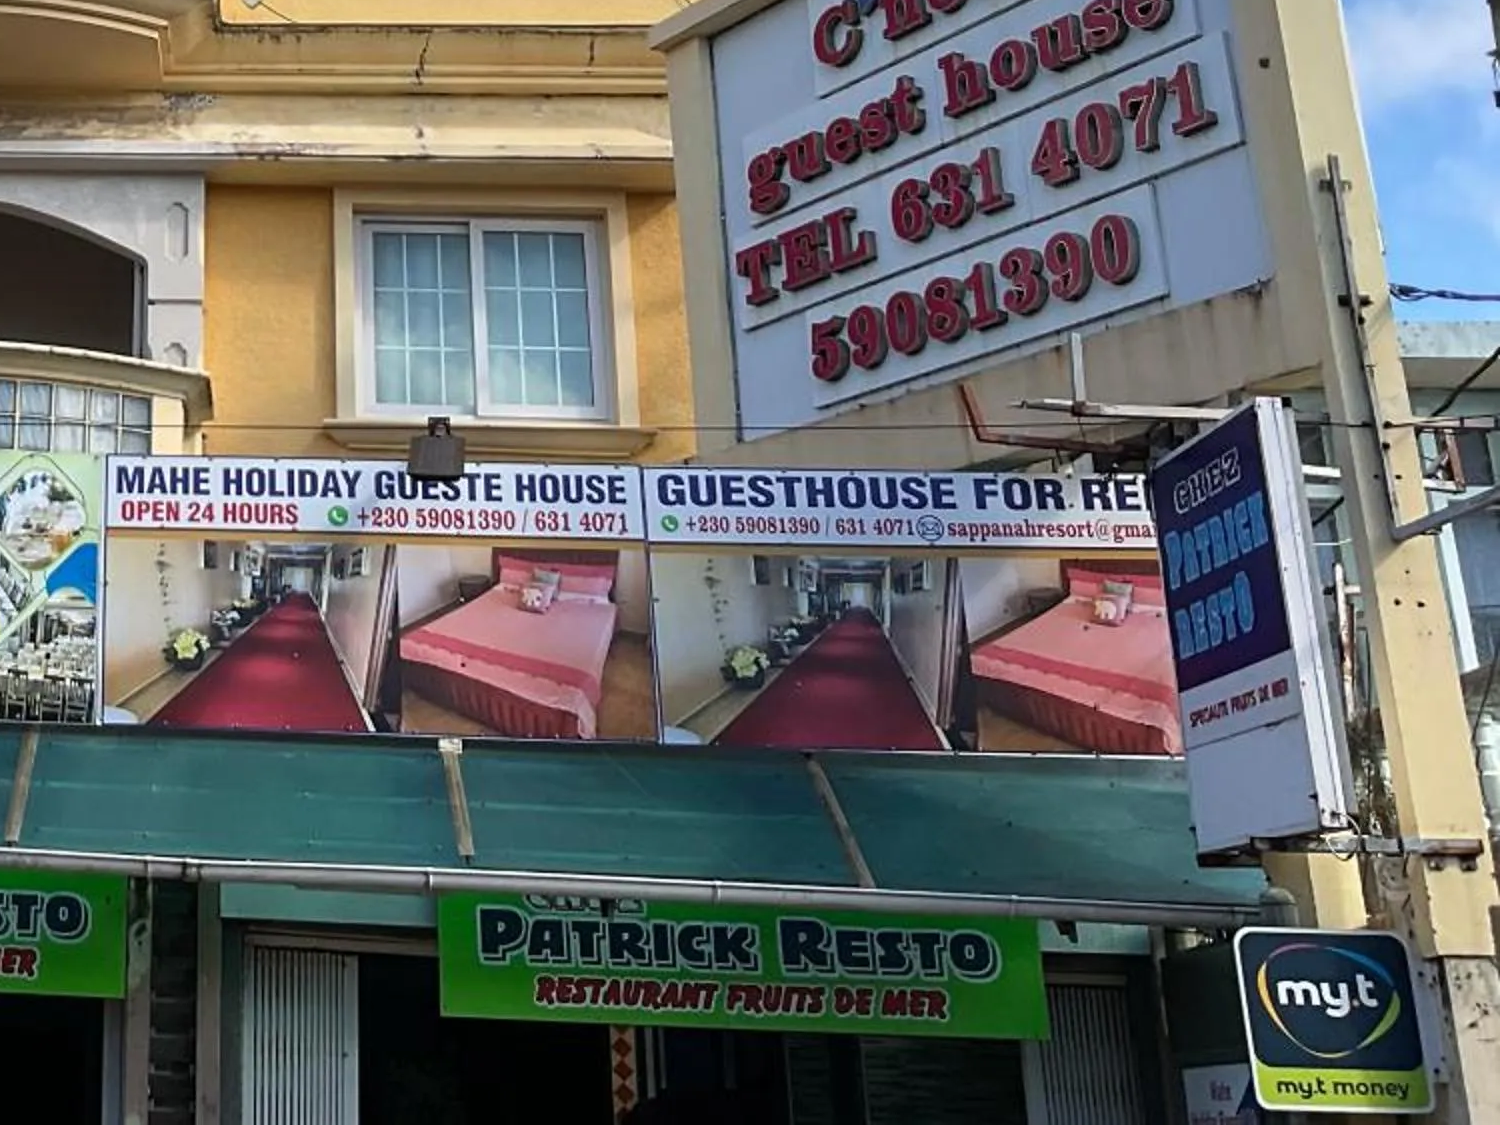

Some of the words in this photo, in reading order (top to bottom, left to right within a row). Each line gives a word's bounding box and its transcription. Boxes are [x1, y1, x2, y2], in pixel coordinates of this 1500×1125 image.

[746, 73, 927, 215] guest
[736, 206, 877, 306] TEL
[891, 147, 1015, 242] 631
[1031, 61, 1218, 185] 4071
[811, 214, 1140, 382] 59081390
[116, 466, 211, 496] MAHE
[223, 468, 362, 498] HOLIDAY
[375, 472, 500, 502] GUESTE
[515, 474, 627, 504] HOUSE
[657, 474, 957, 509] GUESTHOUSE
[973, 478, 1065, 510] FOR
[1081, 478, 1155, 510] RE
[1172, 447, 1241, 515] CHEZ
[121, 501, 179, 522] OPEN
[187, 502, 215, 522] 24
[223, 503, 298, 524] HOURS
[356, 508, 408, 528] +230
[415, 508, 515, 531] 59081390
[535, 511, 571, 532] 631
[579, 512, 628, 533] 4071
[686, 516, 729, 534] +230
[735, 516, 820, 535] 59081390
[835, 518, 866, 536] 631
[873, 518, 914, 537] 4071
[1173, 570, 1256, 660] RESTO
[475, 905, 761, 973] PATRICK
[776, 916, 1002, 981] RESTO
[534, 976, 720, 1013] RESTAURANT
[725, 982, 826, 1019] FRUITS
[834, 986, 875, 1019] DE
[881, 988, 948, 1021] MER
[1277, 974, 1378, 1018] my.t
[1277, 1077, 1326, 1099] my.t
[1333, 1079, 1409, 1099] money
